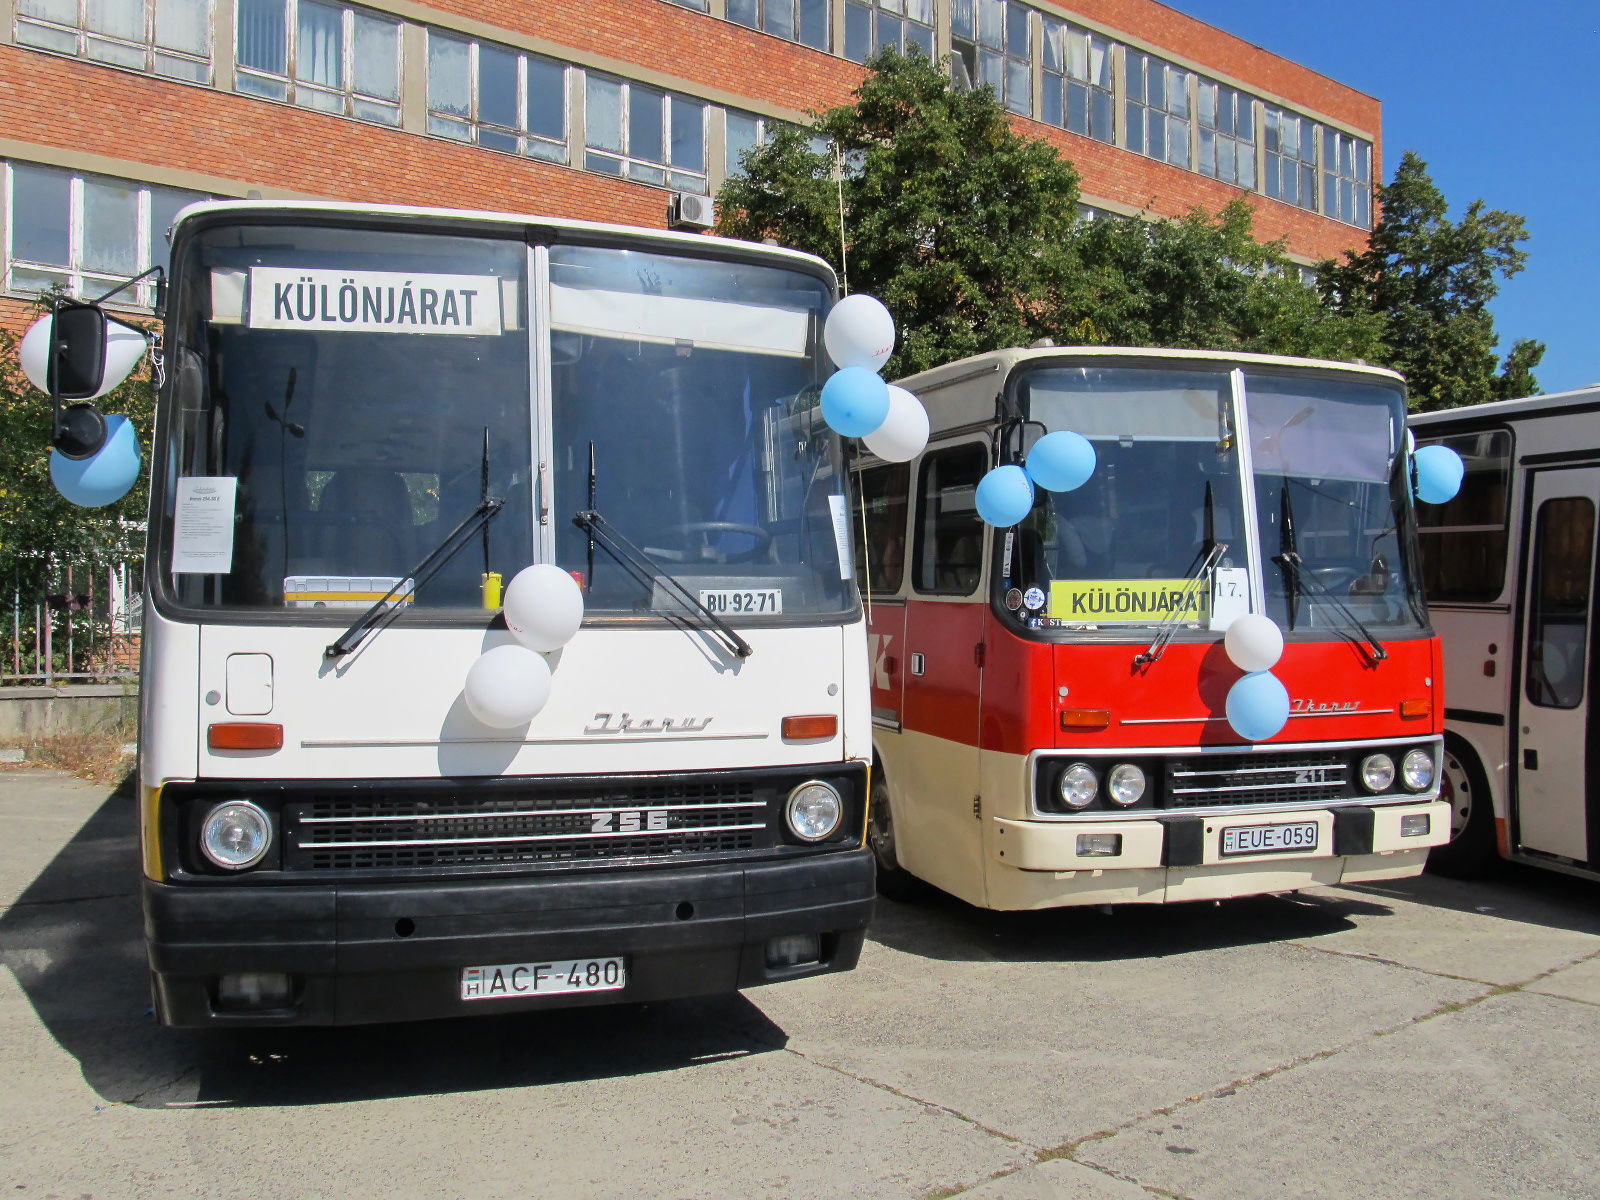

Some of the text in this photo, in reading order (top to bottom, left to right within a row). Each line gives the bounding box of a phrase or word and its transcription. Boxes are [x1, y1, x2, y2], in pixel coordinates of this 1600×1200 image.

[274, 276, 478, 326] KÜLÖNJÁRAT
[1072, 587, 1210, 614] KÜLÖNJÁRAT
[583, 712, 714, 735] Ikarus
[591, 810, 668, 832] 256
[1238, 826, 1315, 849] EUE-059
[489, 960, 619, 994] ACF-480
